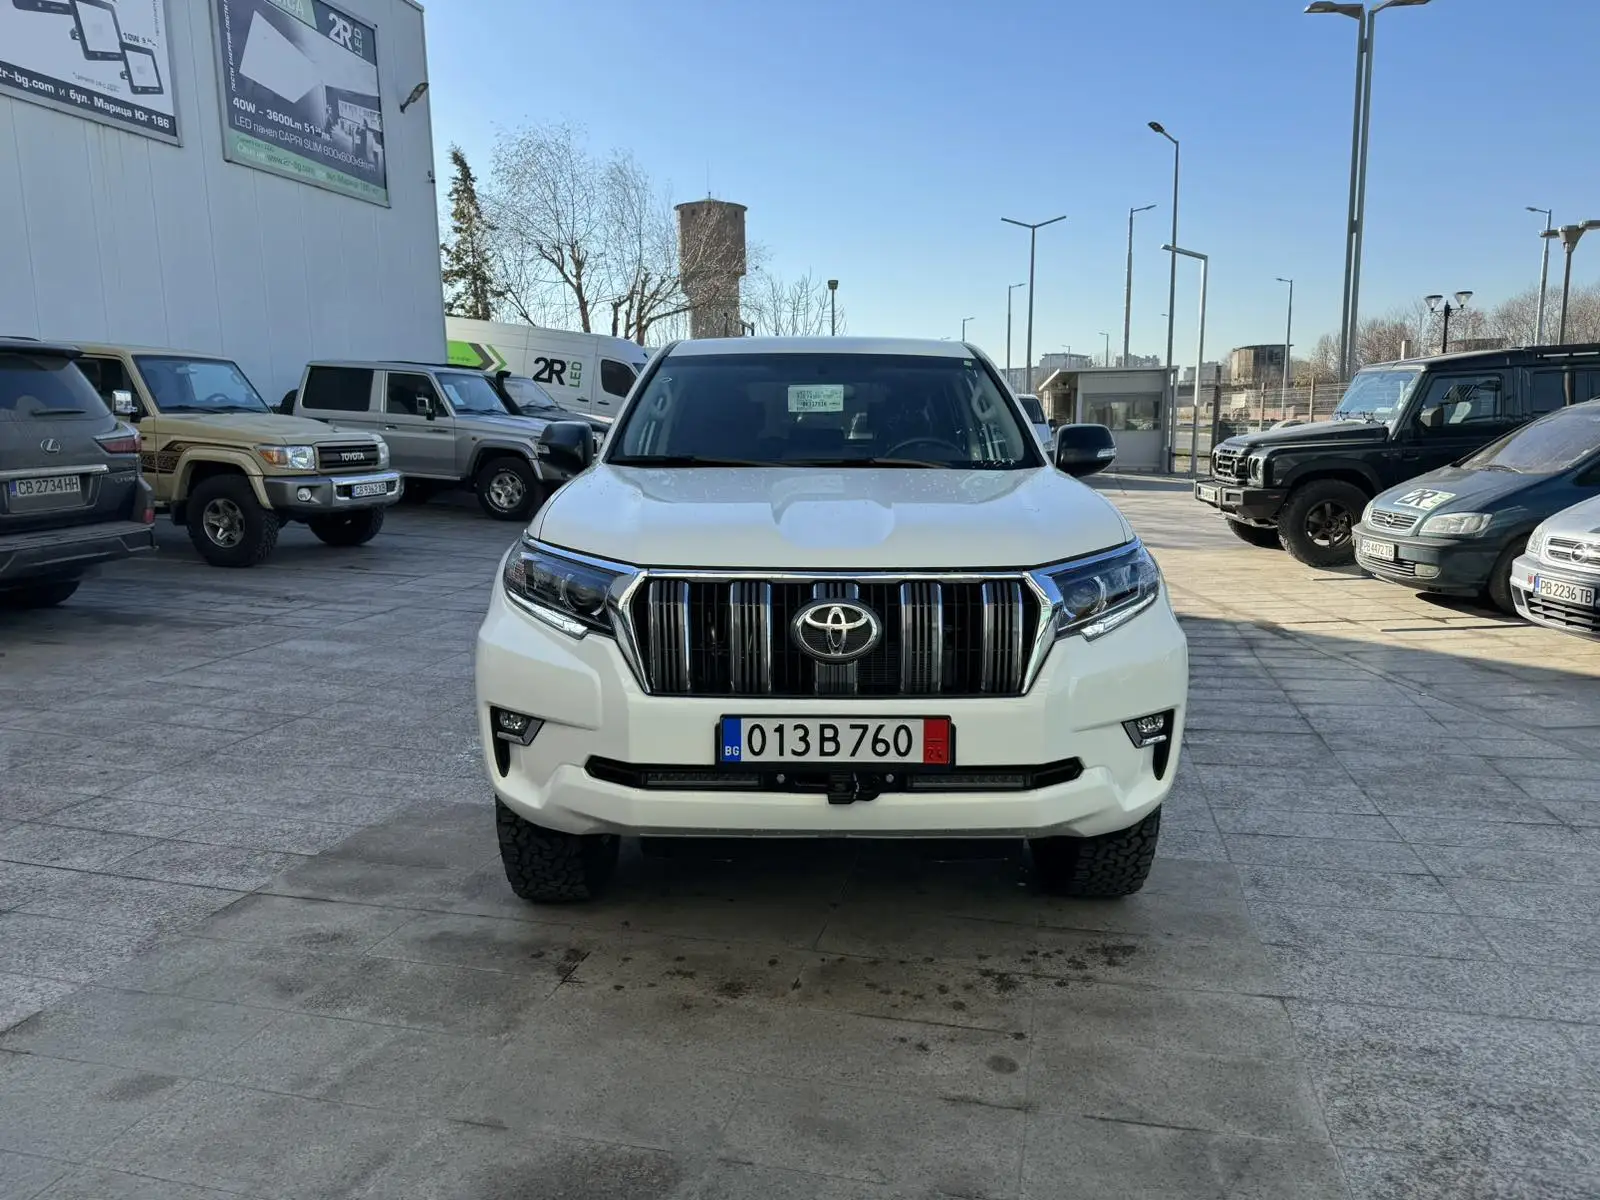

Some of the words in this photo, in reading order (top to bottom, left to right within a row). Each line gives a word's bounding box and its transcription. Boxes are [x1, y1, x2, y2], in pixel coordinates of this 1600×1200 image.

[328, 12, 353, 51] 2R
[354, 28, 363, 57] LED
[69, 89, 91, 104] бул.
[93, 96, 132, 117] Марица
[134, 109, 149, 122] Юг
[151, 115, 170, 128] 186
[232, 97, 256, 114] 40W
[266, 109, 302, 131] 3600Lm
[234, 113, 252, 130] LED
[278, 129, 303, 147] CAPRI
[532, 356, 567, 386] 2R
[569, 360, 582, 388] LED
[340, 452, 365, 462] TOYOTA
[36, 476, 63, 494] 2734
[1553, 583, 1577, 601] 2236
[724, 745, 740, 757] BG
